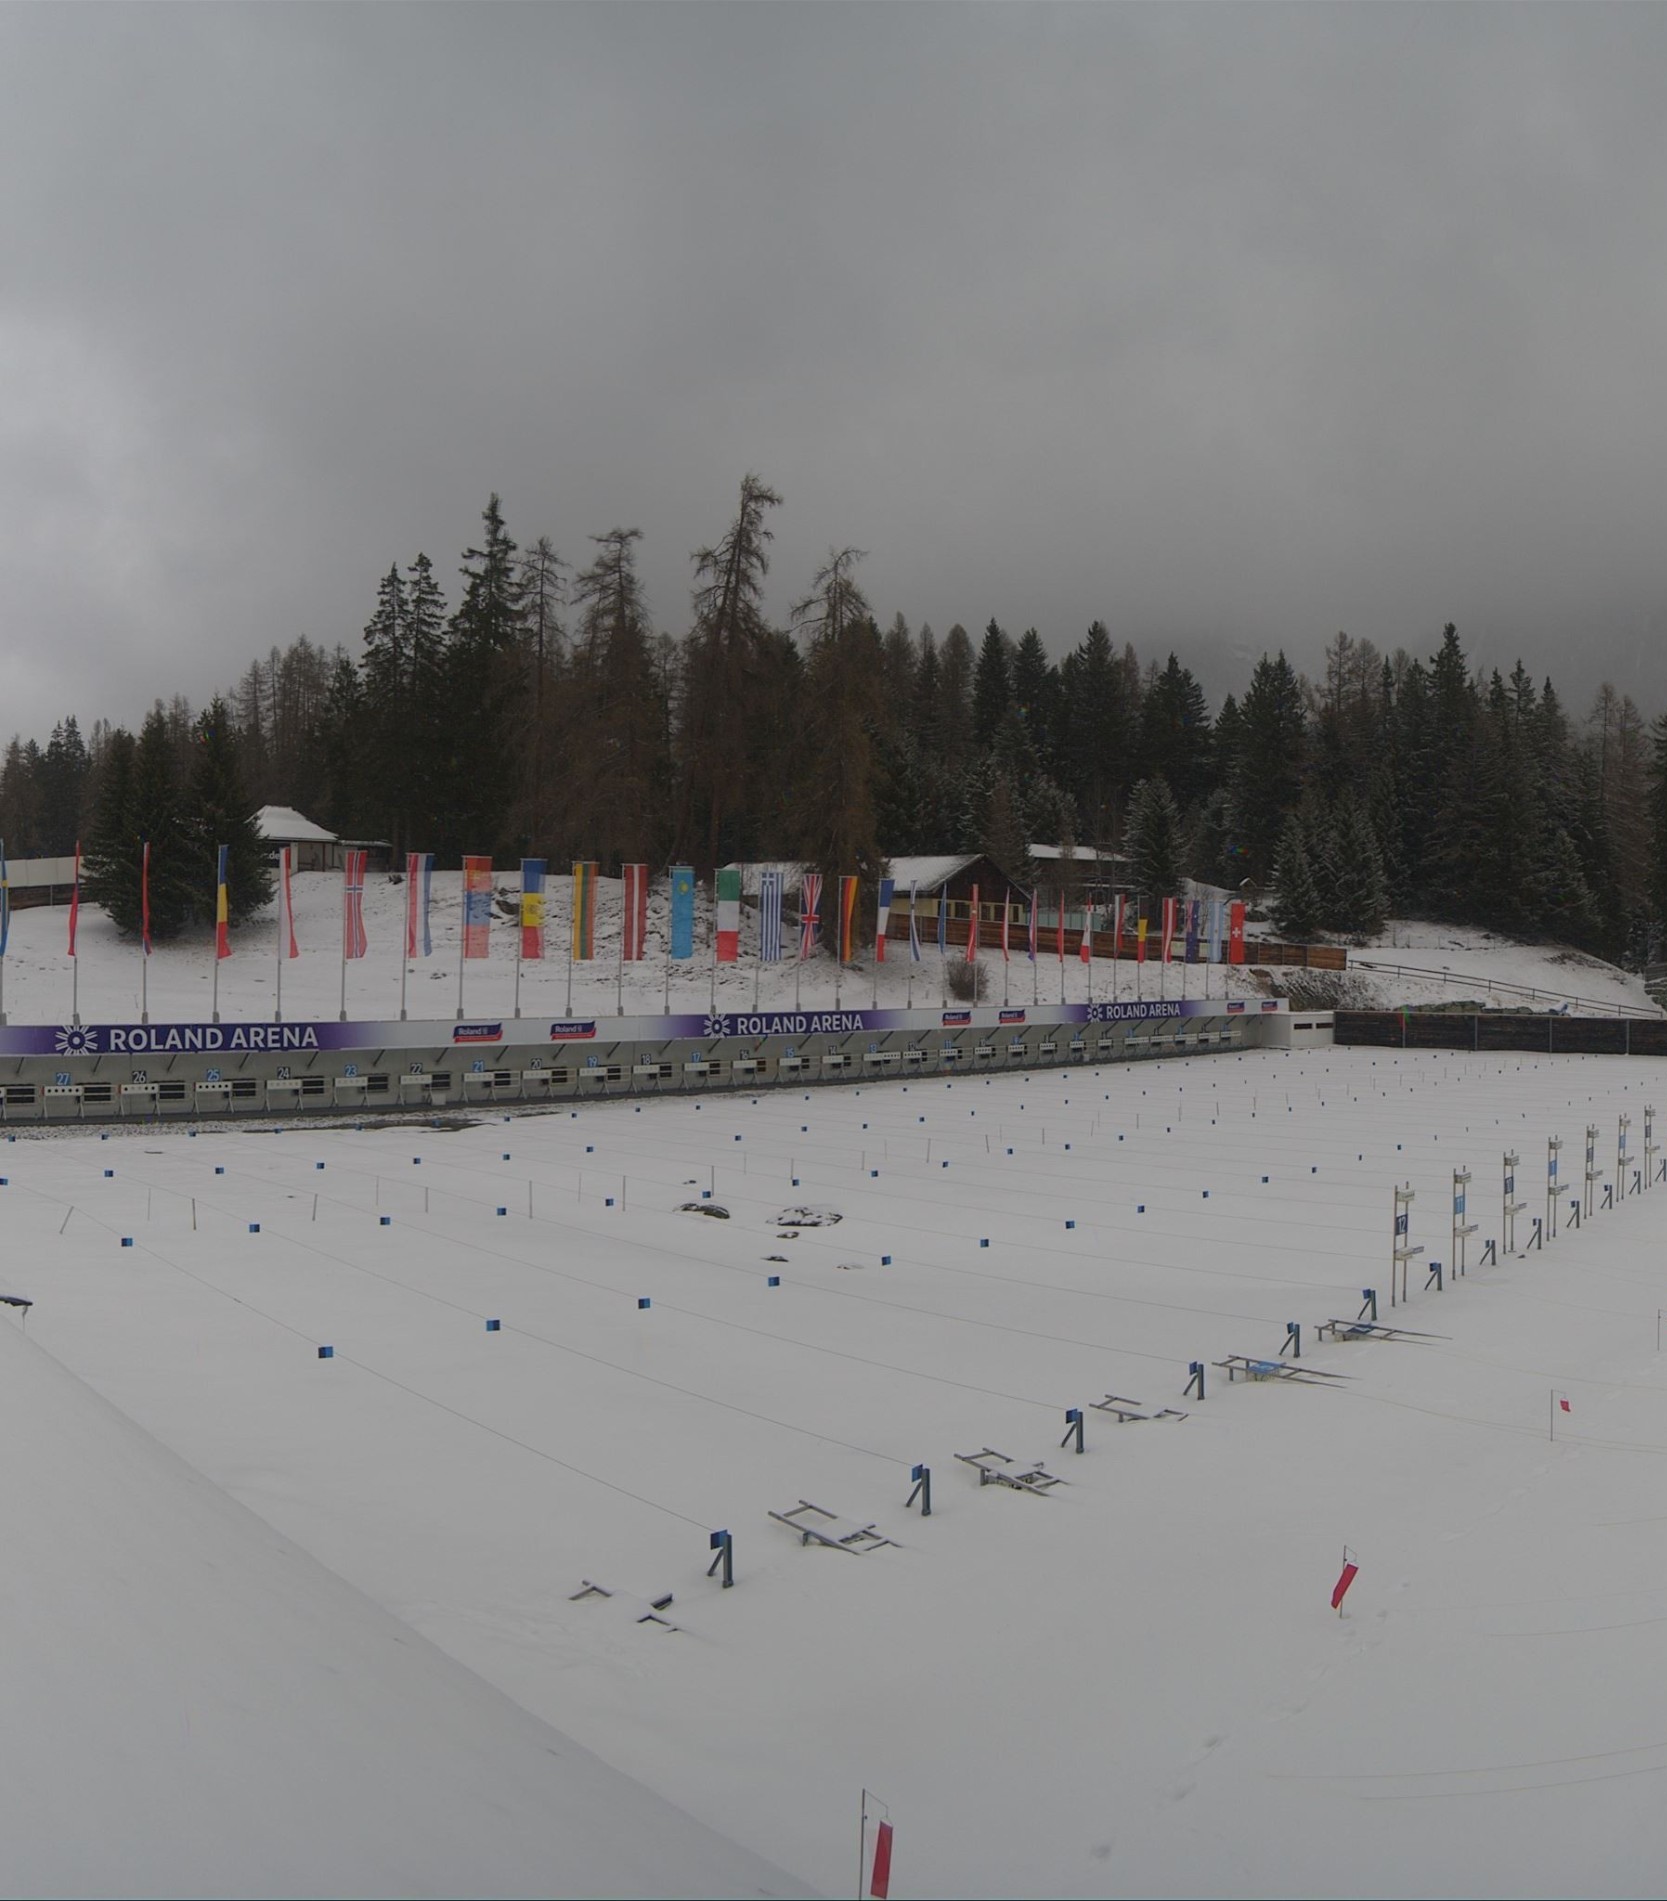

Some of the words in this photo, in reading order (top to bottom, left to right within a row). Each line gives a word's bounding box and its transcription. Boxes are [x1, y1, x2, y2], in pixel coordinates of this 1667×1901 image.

[1106, 1006, 1147, 1018] ROLAND
[1149, 1003, 1181, 1016] ARENA
[555, 1024, 577, 1033] Roland
[737, 1017, 807, 1035] ROLAND
[811, 1014, 864, 1031] ARENA
[458, 1027, 480, 1035] Roland
[109, 1029, 223, 1050] ROLAND
[230, 1026, 319, 1048] ARENA
[411, 1064, 421, 1073] 22
[474, 1062, 483, 1071] 21
[531, 1059, 541, 1068] 20
[207, 1069, 219, 1080] 25
[278, 1068, 290, 1079] 24
[345, 1066, 356, 1076] 23
[56, 1074, 70, 1085] 27
[133, 1072, 146, 1083] 26
[1398, 1216, 1406, 1232] 12
